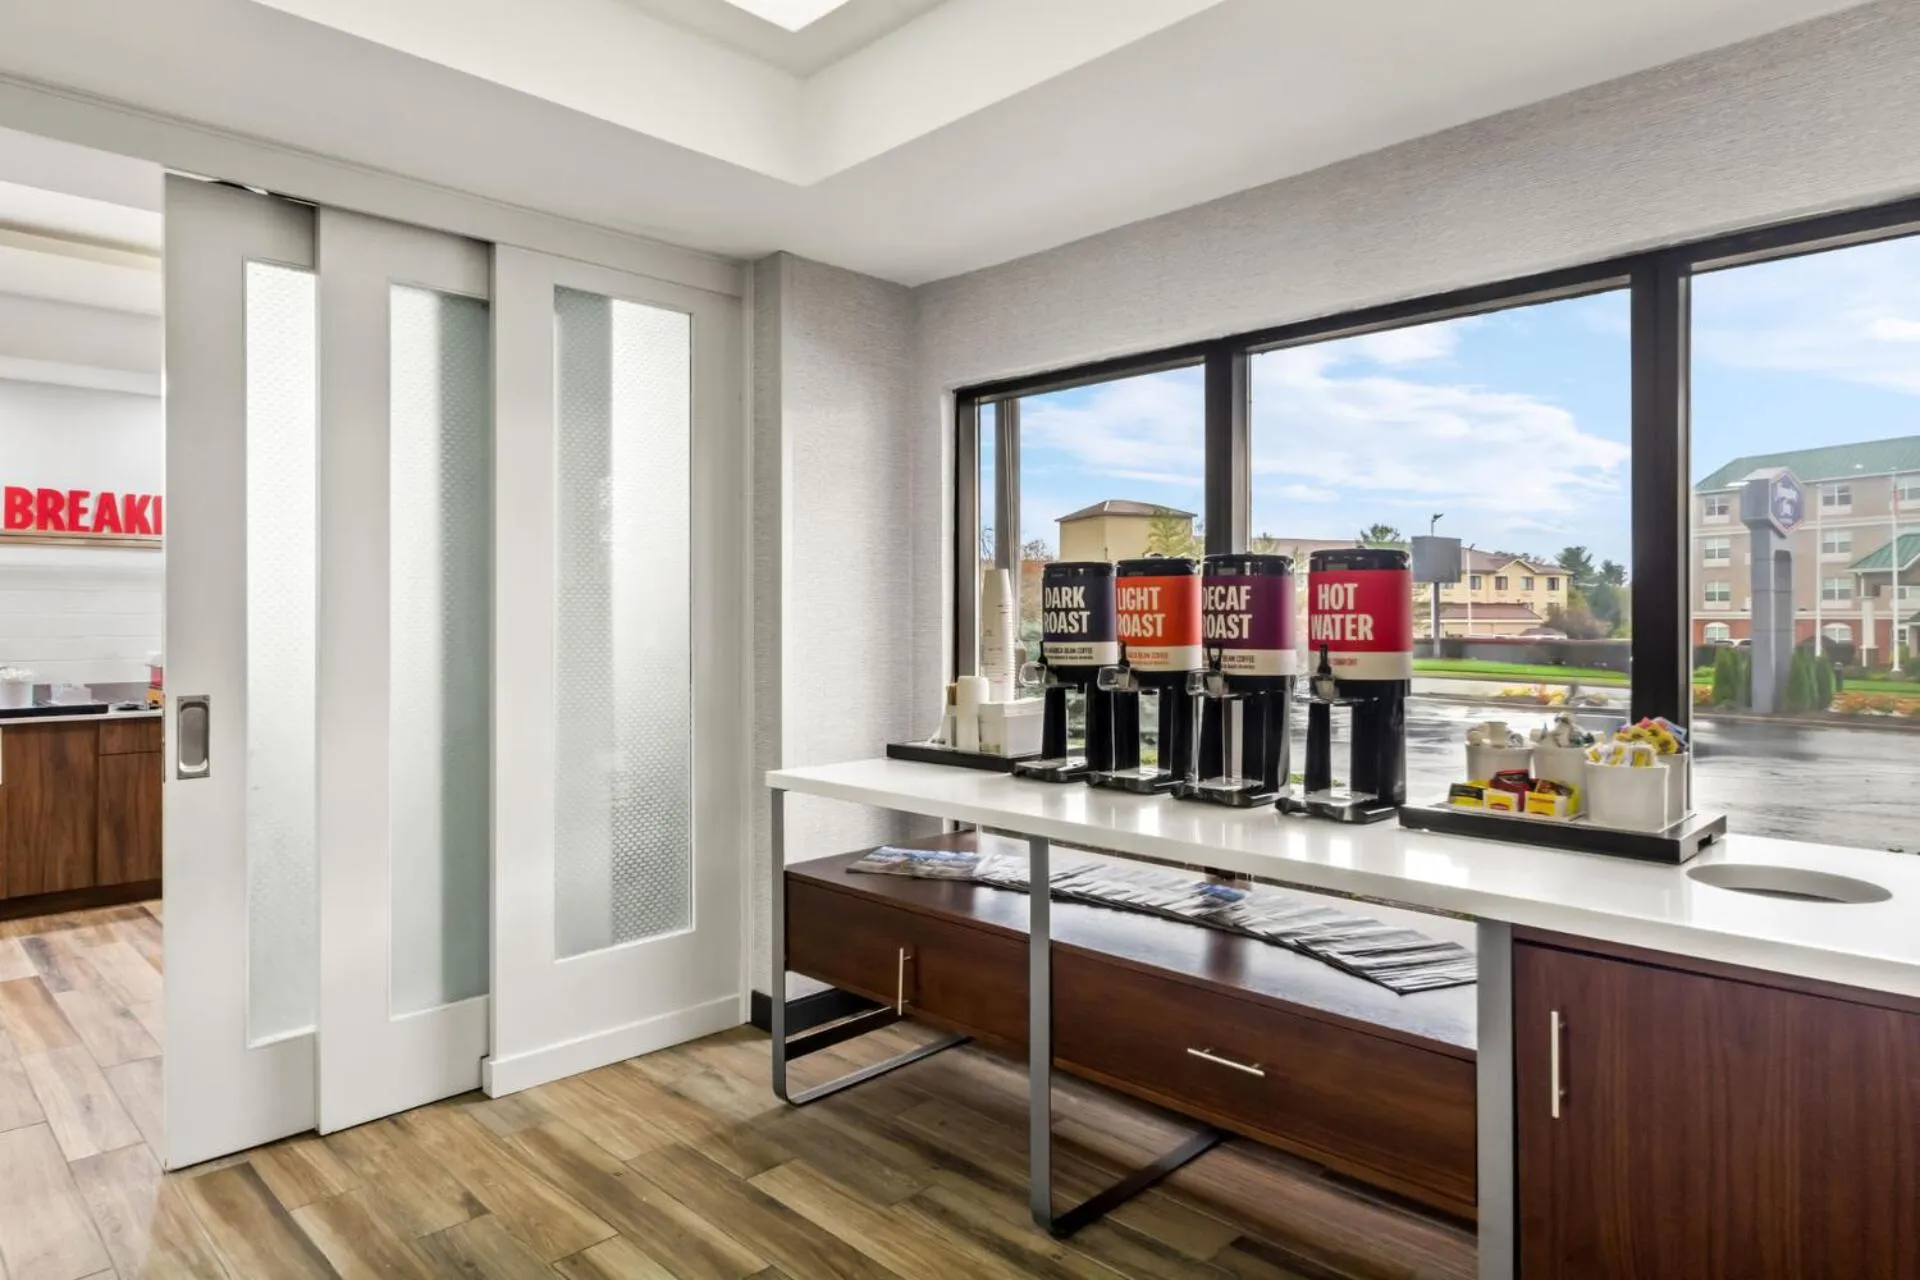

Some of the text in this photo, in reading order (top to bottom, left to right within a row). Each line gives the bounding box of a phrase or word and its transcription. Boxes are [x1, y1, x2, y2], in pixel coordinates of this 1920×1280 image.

[1045, 586, 1085, 609] DARK
[1117, 586, 1162, 611] LIGHT
[1317, 583, 1359, 610] HOT
[1043, 611, 1091, 634] ROAST
[1310, 613, 1375, 641] WATER
